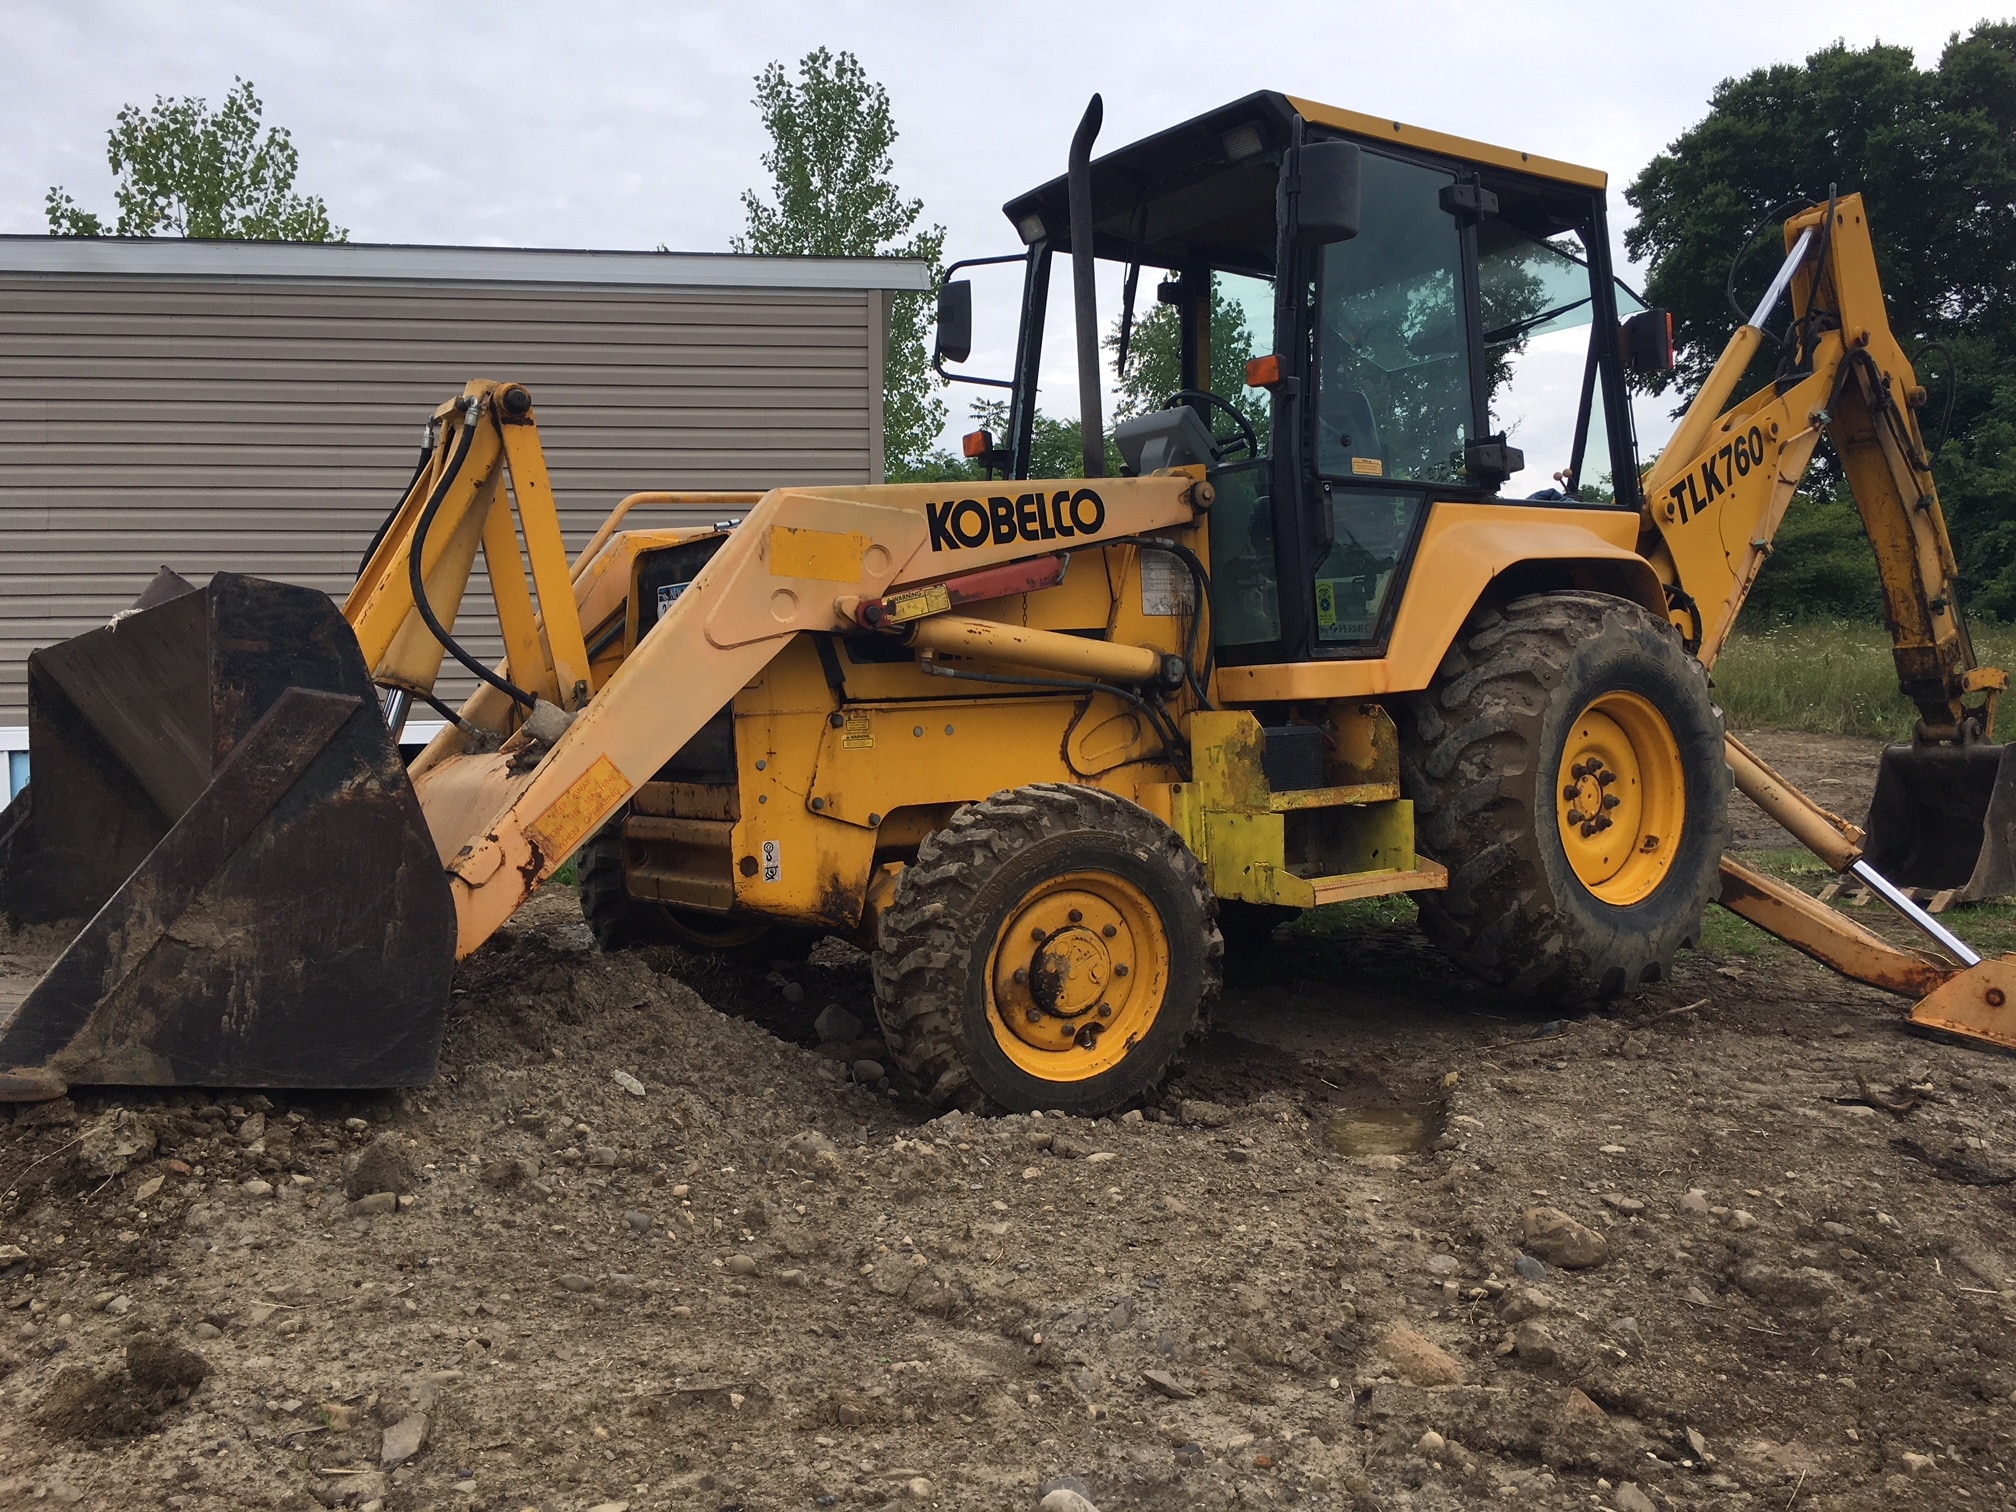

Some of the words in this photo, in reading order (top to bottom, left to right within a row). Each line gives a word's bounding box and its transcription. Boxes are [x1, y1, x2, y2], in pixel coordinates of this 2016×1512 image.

[1669, 426, 1764, 525] TLK760
[926, 488, 1106, 552] KOBELCO
[892, 591, 922, 603] WARNING
[551, 801, 567, 818] KEEP
[572, 778, 591, 799] AWAY
[558, 826, 580, 849] WHEN
[582, 787, 620, 824] OPERATING
[567, 807, 581, 821] THE
[584, 773, 617, 804] MACHINE
